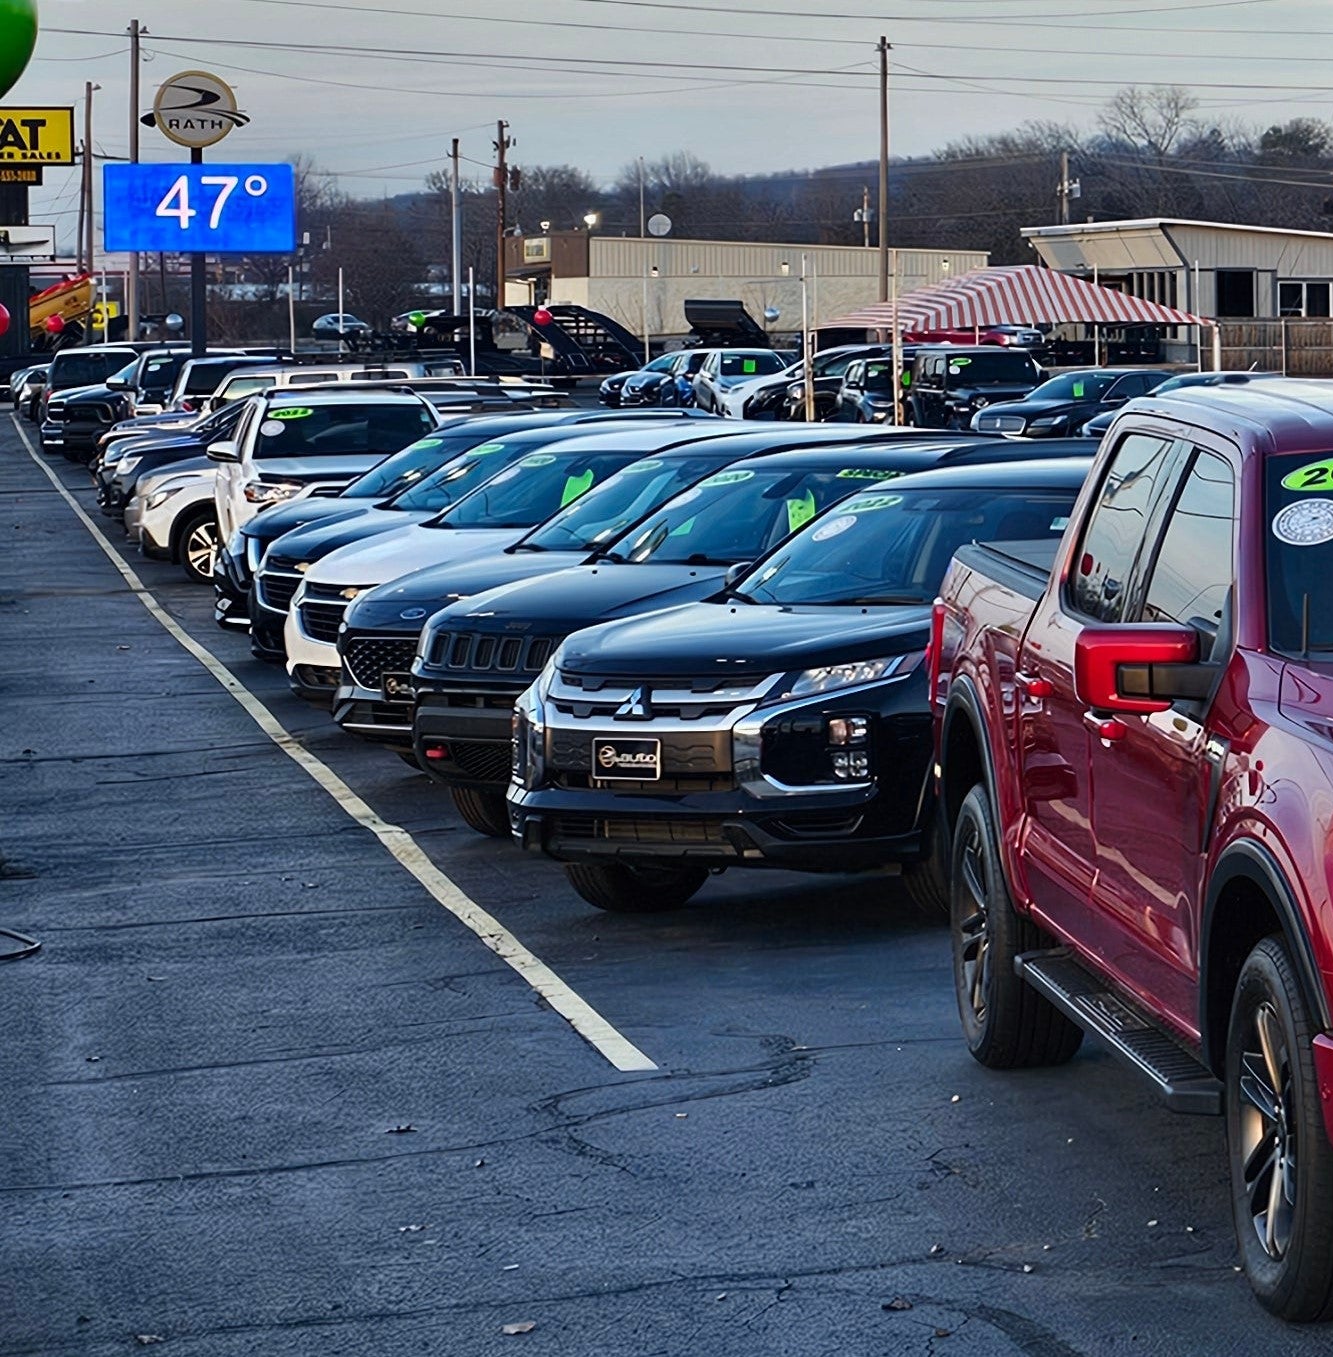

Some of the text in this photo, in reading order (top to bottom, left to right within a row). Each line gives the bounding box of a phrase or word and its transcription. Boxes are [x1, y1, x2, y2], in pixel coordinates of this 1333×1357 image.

[0, 118, 47, 150] AT
[168, 119, 223, 130] RATH
[156, 175, 267, 230] 47°
